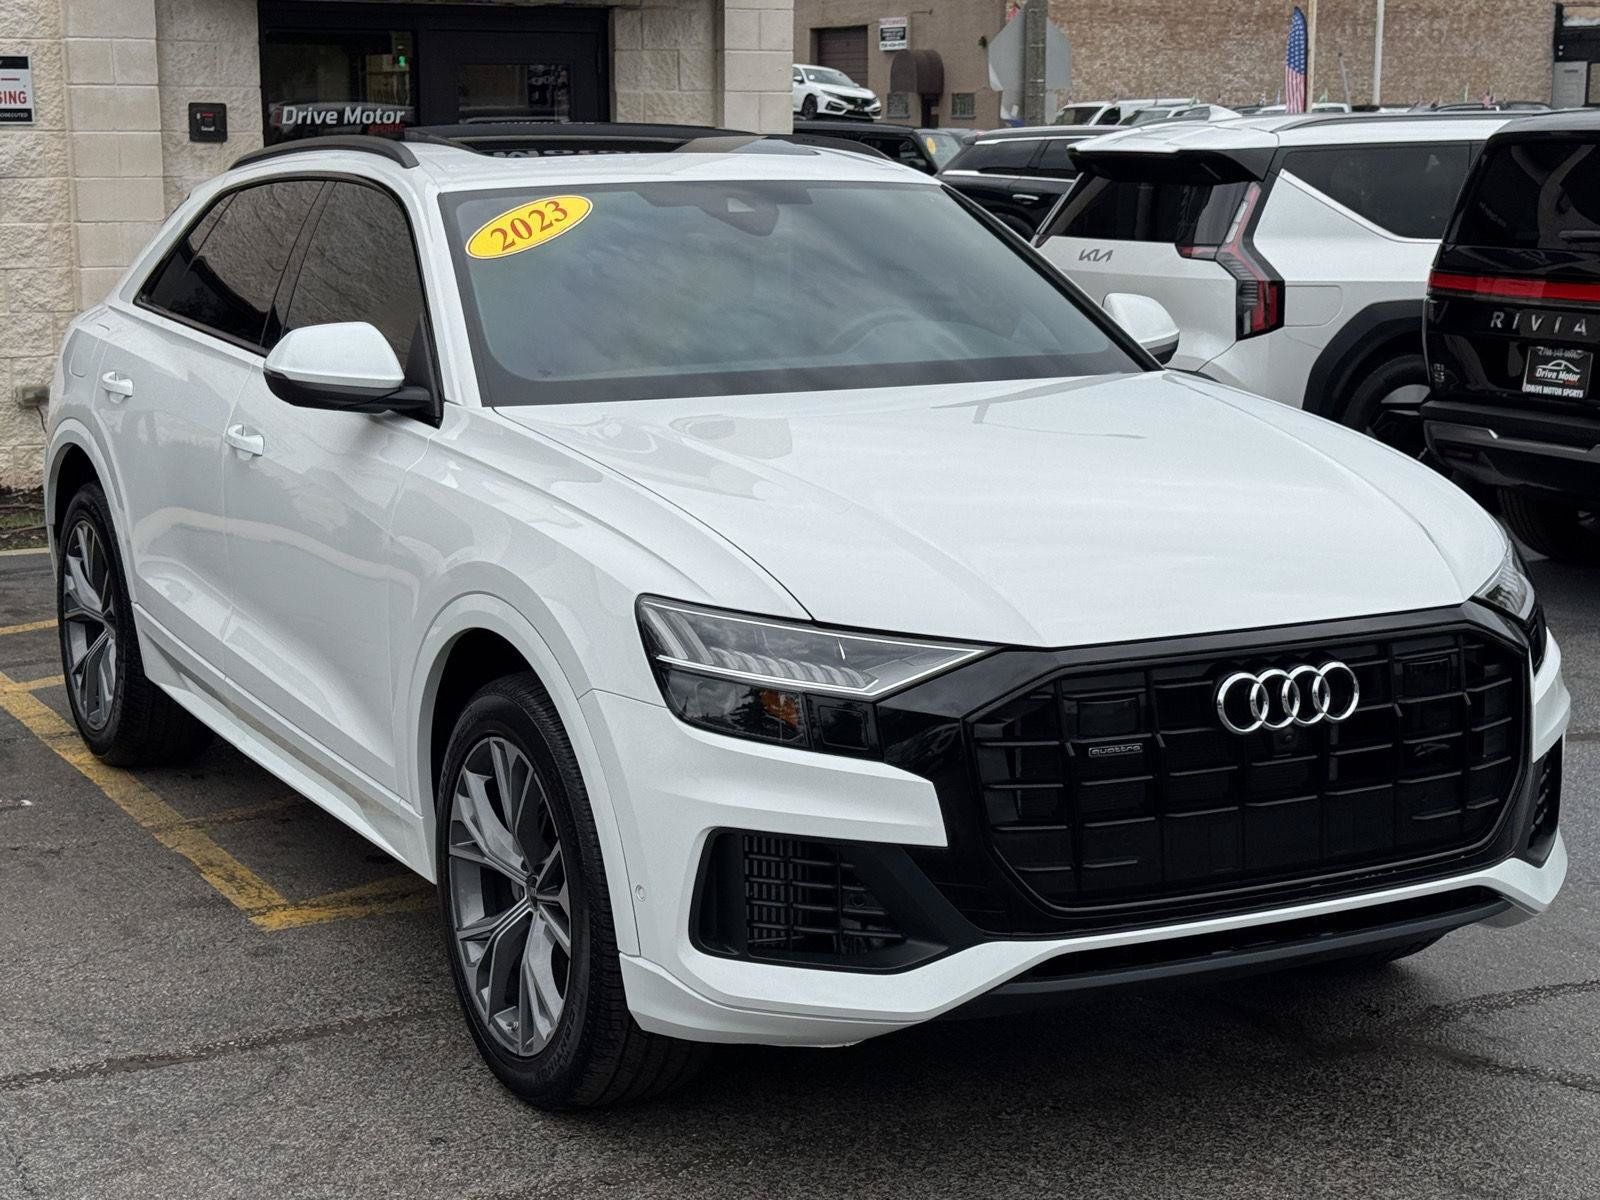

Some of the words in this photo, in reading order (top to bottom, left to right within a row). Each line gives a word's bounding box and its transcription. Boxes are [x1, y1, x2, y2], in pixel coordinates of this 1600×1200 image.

[343, 106, 406, 125] Motor
[490, 200, 568, 251] 2023
[1562, 388, 1584, 398] SPORTS
[1090, 744, 1141, 756] quattro
